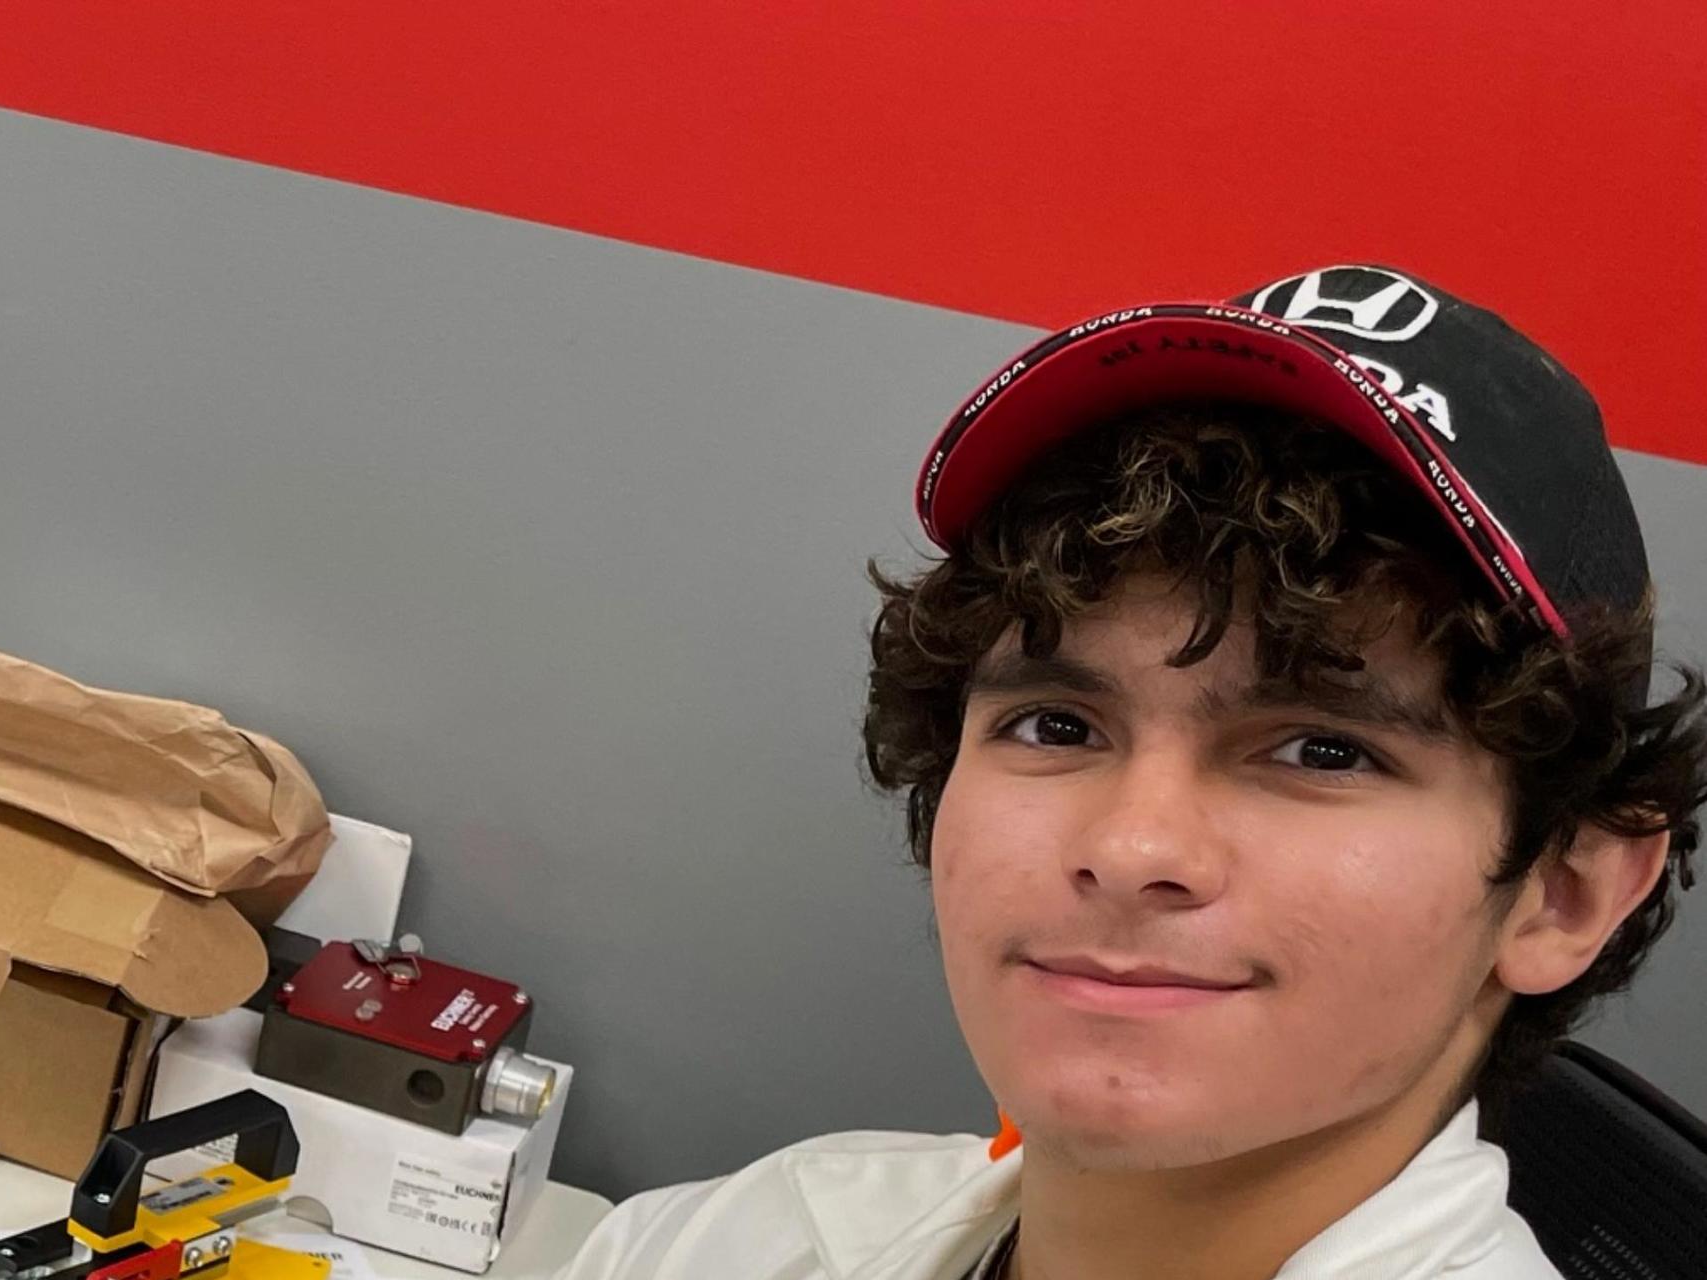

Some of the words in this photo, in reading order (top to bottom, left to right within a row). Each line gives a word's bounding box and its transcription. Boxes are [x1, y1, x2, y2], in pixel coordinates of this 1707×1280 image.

[1069, 306, 1152, 338] HONDA
[1205, 306, 1291, 336] HONDA
[964, 360, 1027, 418] HONDA
[1334, 359, 1400, 424] HONDA
[1428, 460, 1476, 529] HONDA
